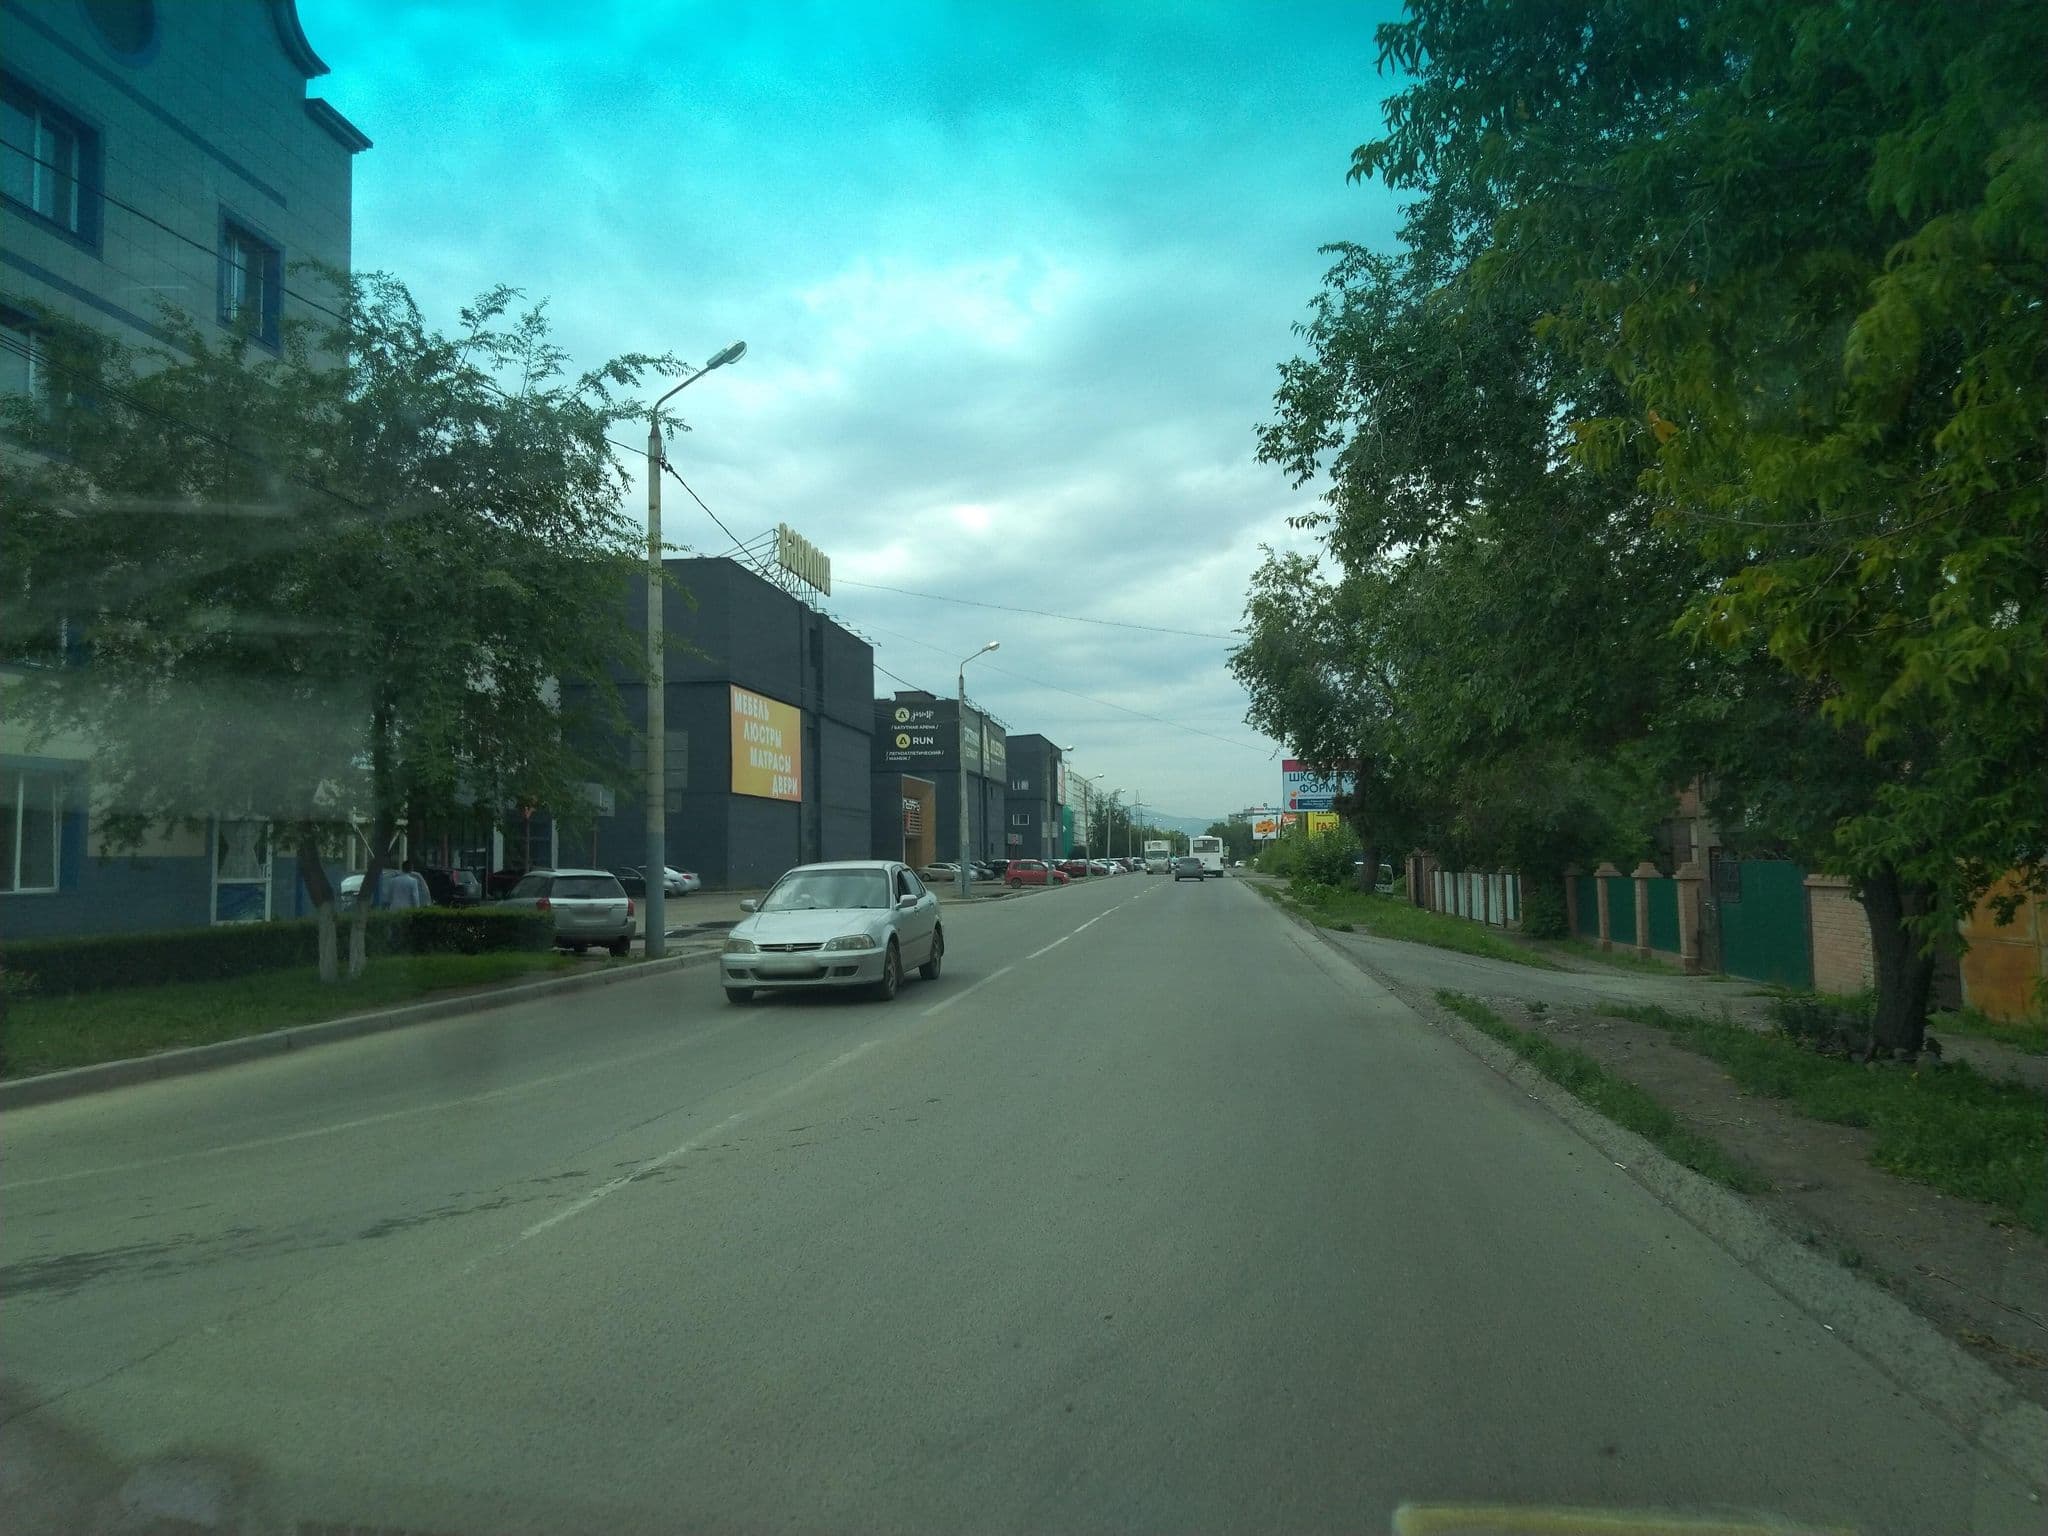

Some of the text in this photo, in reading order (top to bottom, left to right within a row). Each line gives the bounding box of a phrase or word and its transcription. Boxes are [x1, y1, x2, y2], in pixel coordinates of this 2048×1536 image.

[734, 691, 769, 721] МЕБЕЛЬ
[744, 720, 782, 749] ЛЮСТРЫ
[912, 737, 933, 745] RUN
[750, 746, 791, 774] МАТРАСЫ
[772, 774, 798, 798] ДВЕРИ
